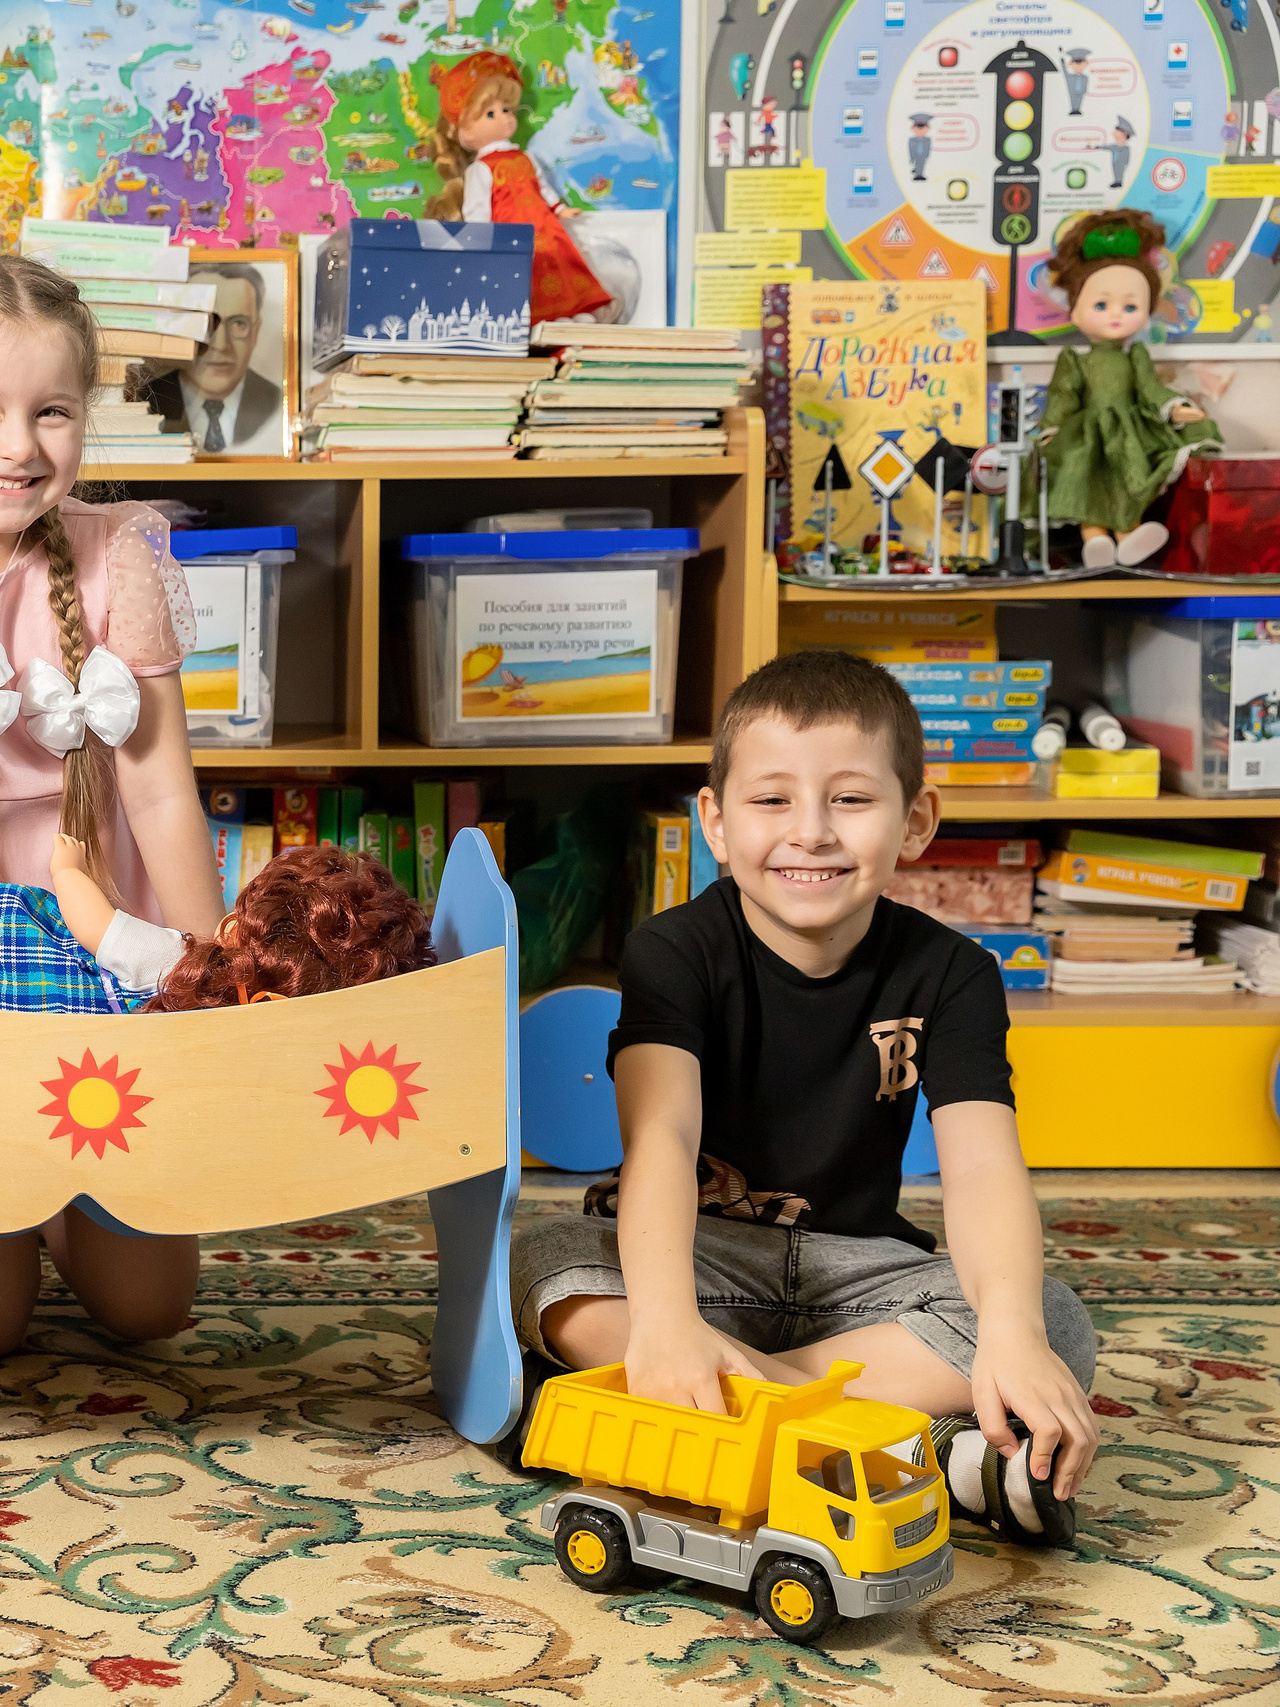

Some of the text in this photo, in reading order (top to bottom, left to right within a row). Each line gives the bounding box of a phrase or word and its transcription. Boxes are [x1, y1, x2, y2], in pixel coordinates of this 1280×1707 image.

[484, 600, 627, 614] Пособия для занятий
[479, 620, 632, 635] по речевому развитию
[539, 638, 600, 652] культура
